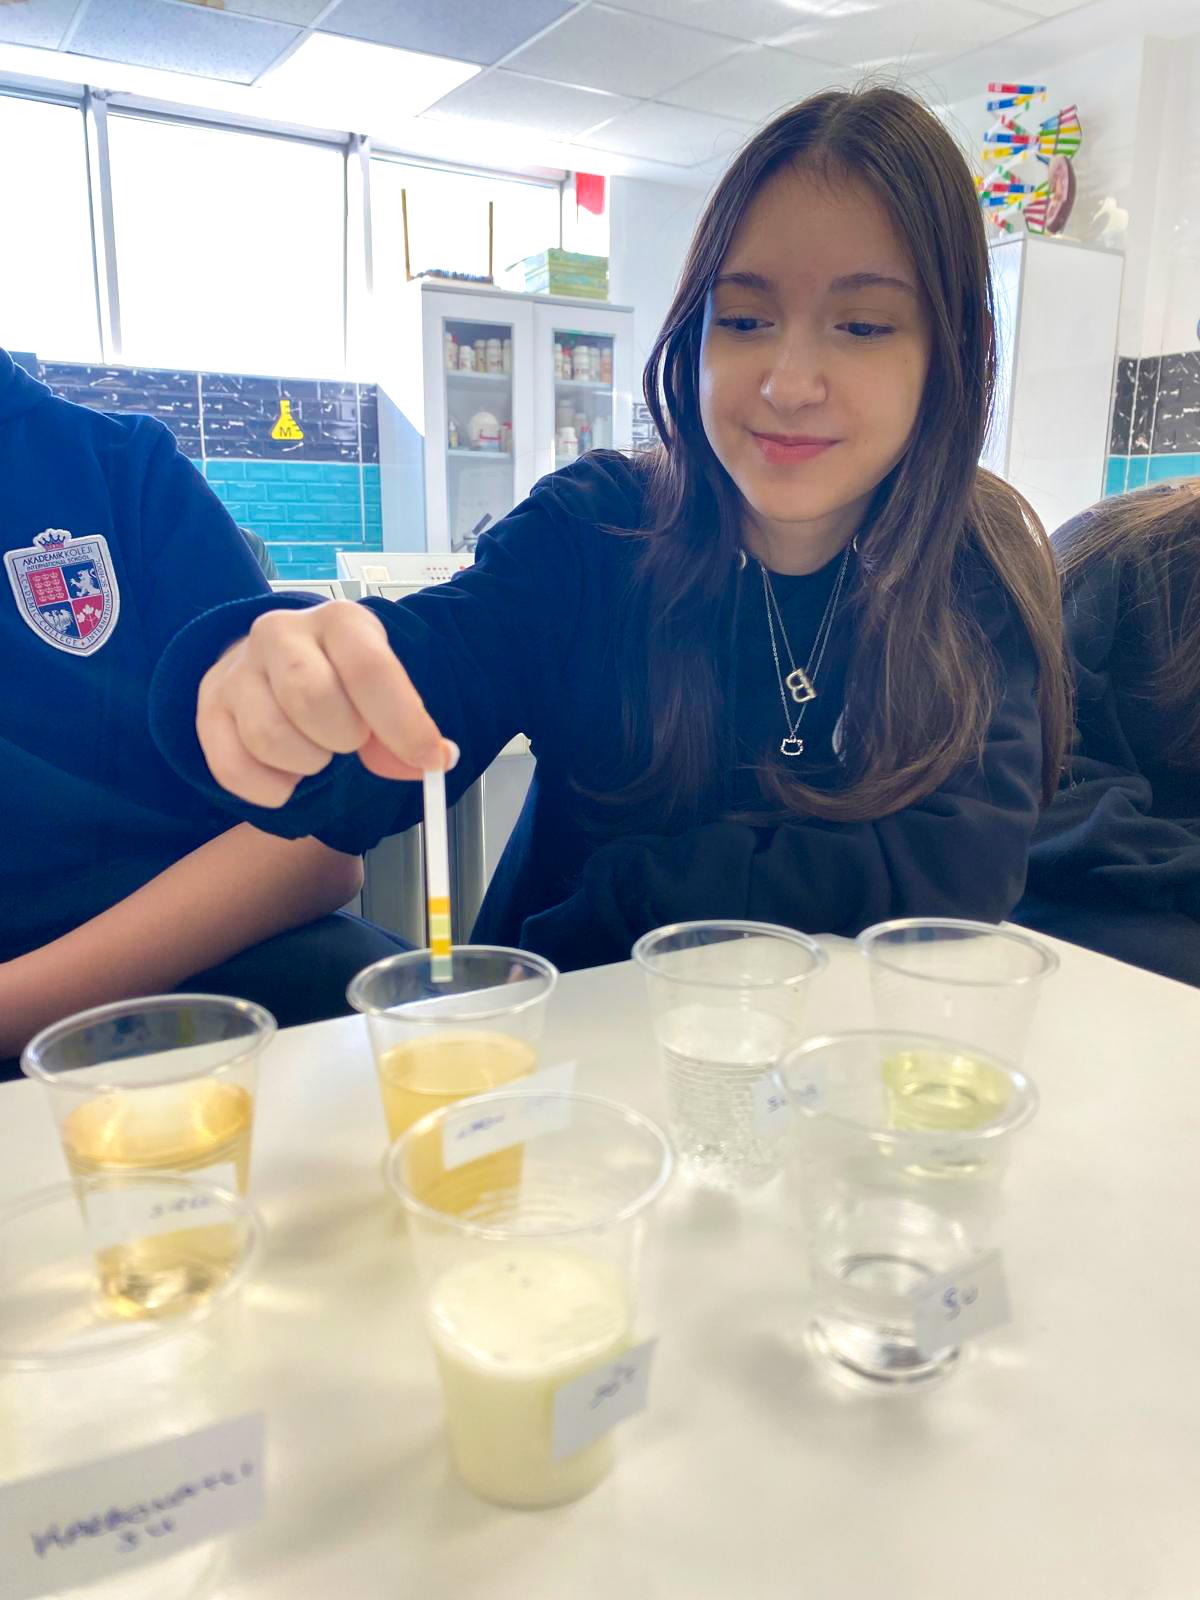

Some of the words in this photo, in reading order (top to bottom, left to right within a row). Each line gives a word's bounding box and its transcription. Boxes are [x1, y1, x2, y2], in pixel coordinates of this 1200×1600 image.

[280, 426, 292, 437] M
[26, 559, 66, 571] INTERNATIONAL
[67, 555, 90, 564] SCHOOL
[96, 558, 108, 588] SCHOOL
[19, 573, 40, 619] ACADEMIC
[40, 620, 78, 645] COLLEGE
[86, 590, 111, 643] INTERNATIONAL
